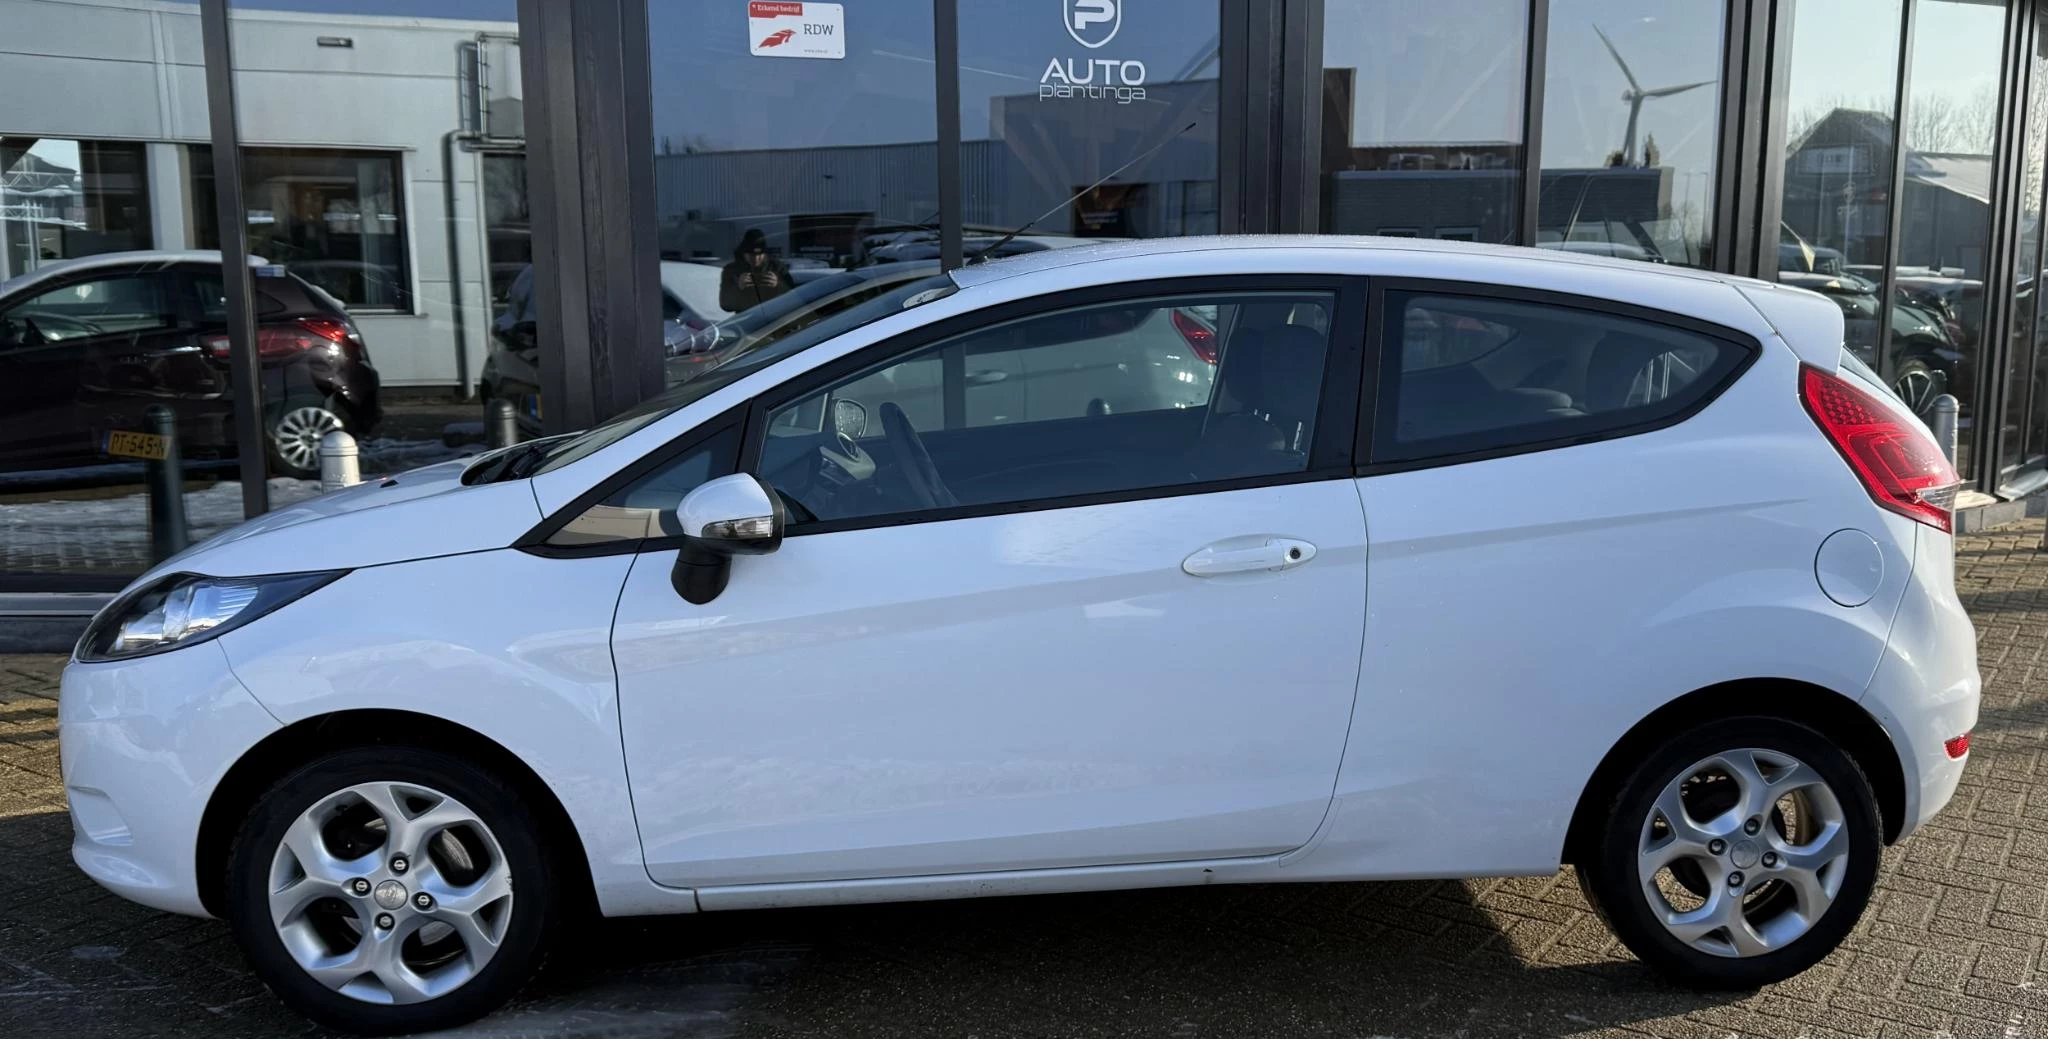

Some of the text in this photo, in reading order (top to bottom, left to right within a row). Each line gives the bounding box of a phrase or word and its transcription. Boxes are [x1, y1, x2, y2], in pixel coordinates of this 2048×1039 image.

[803, 23, 834, 36] RDW
[1040, 57, 1146, 85] AUTO
[1039, 82, 1146, 104] plantinga
